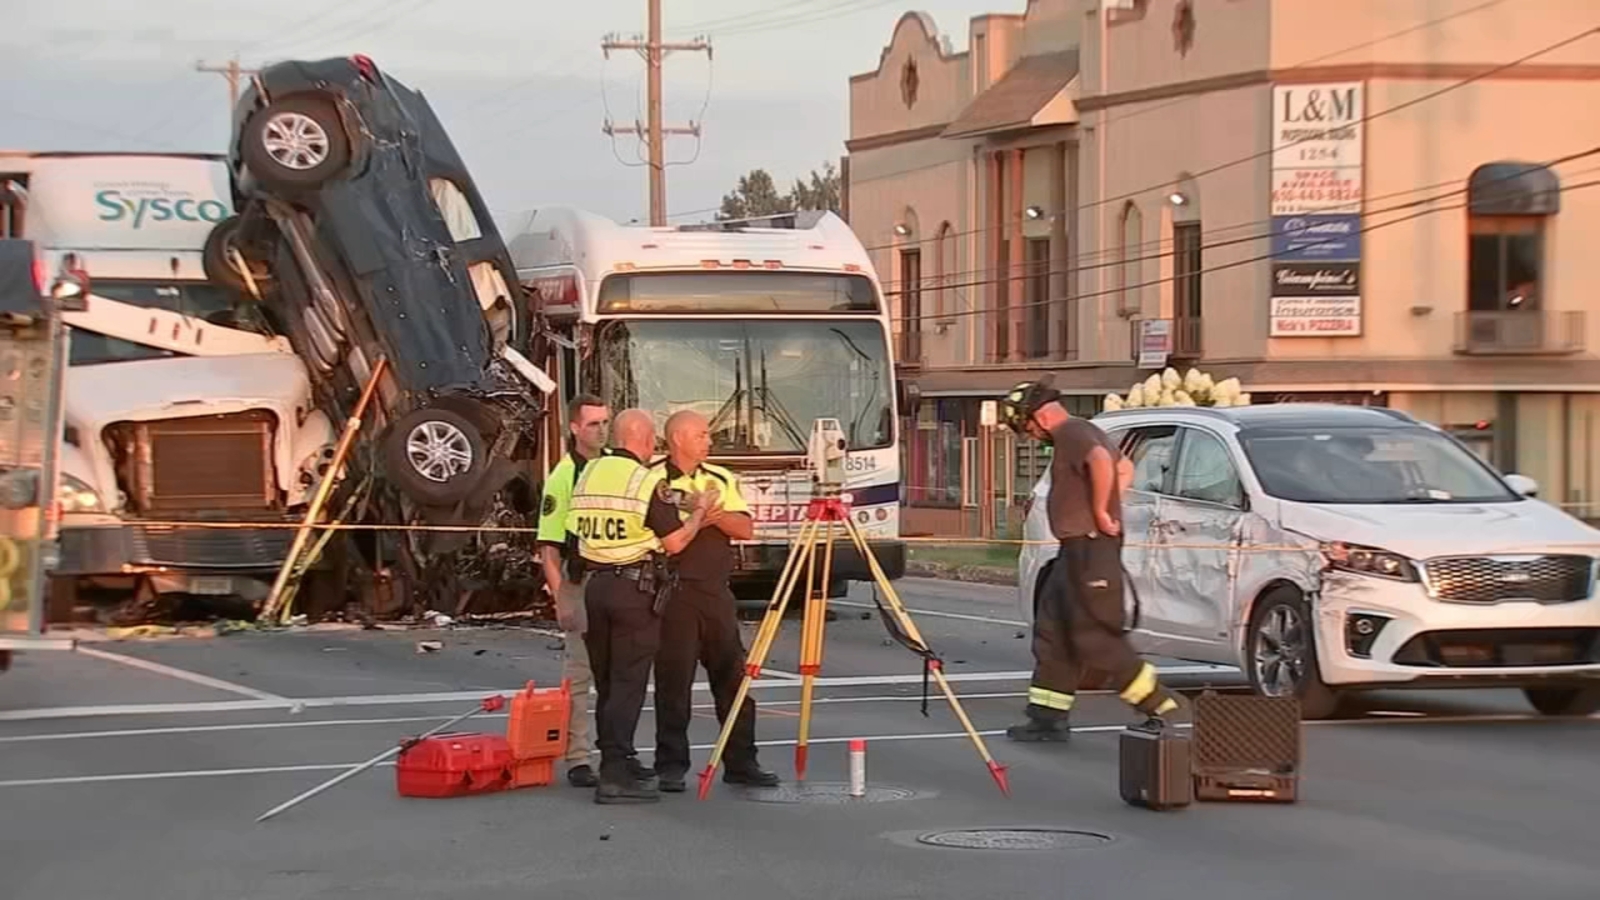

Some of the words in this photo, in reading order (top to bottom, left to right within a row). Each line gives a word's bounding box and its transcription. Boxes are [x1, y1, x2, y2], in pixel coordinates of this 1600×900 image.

[1282, 88, 1356, 122] L&M
[1294, 170, 1337, 180] SPACE
[95, 190, 228, 229] Sysco
[845, 455, 876, 471] 8514
